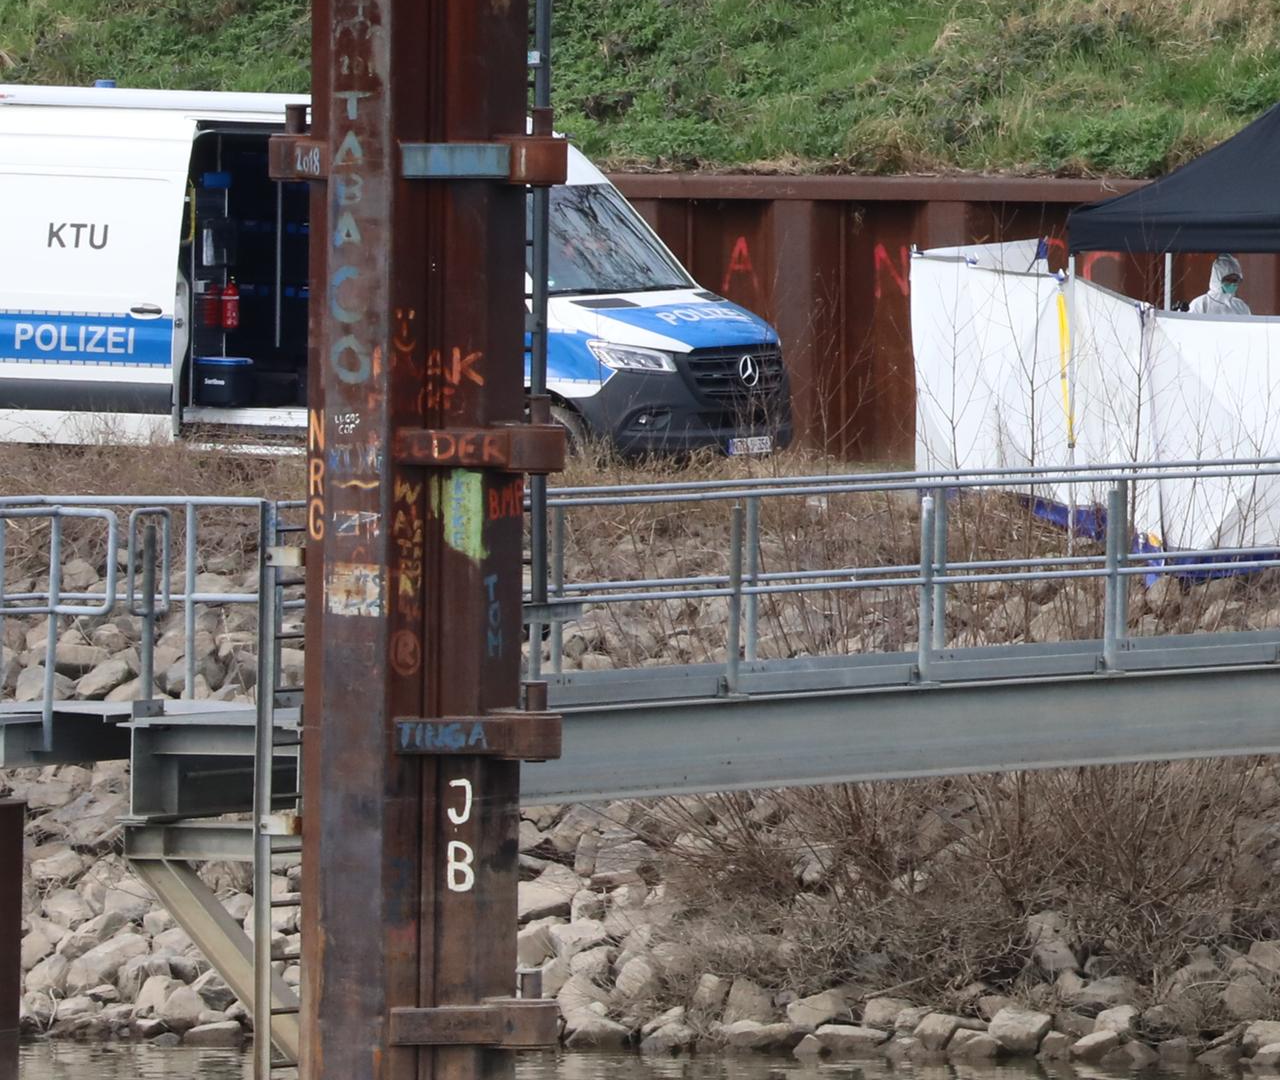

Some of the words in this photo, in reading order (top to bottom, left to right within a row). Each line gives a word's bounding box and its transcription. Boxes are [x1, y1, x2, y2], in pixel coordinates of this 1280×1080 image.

[47, 222, 109, 250] KTU
[655, 307, 754, 326] POLIZEI
[15, 323, 134, 354] POLIZEI
